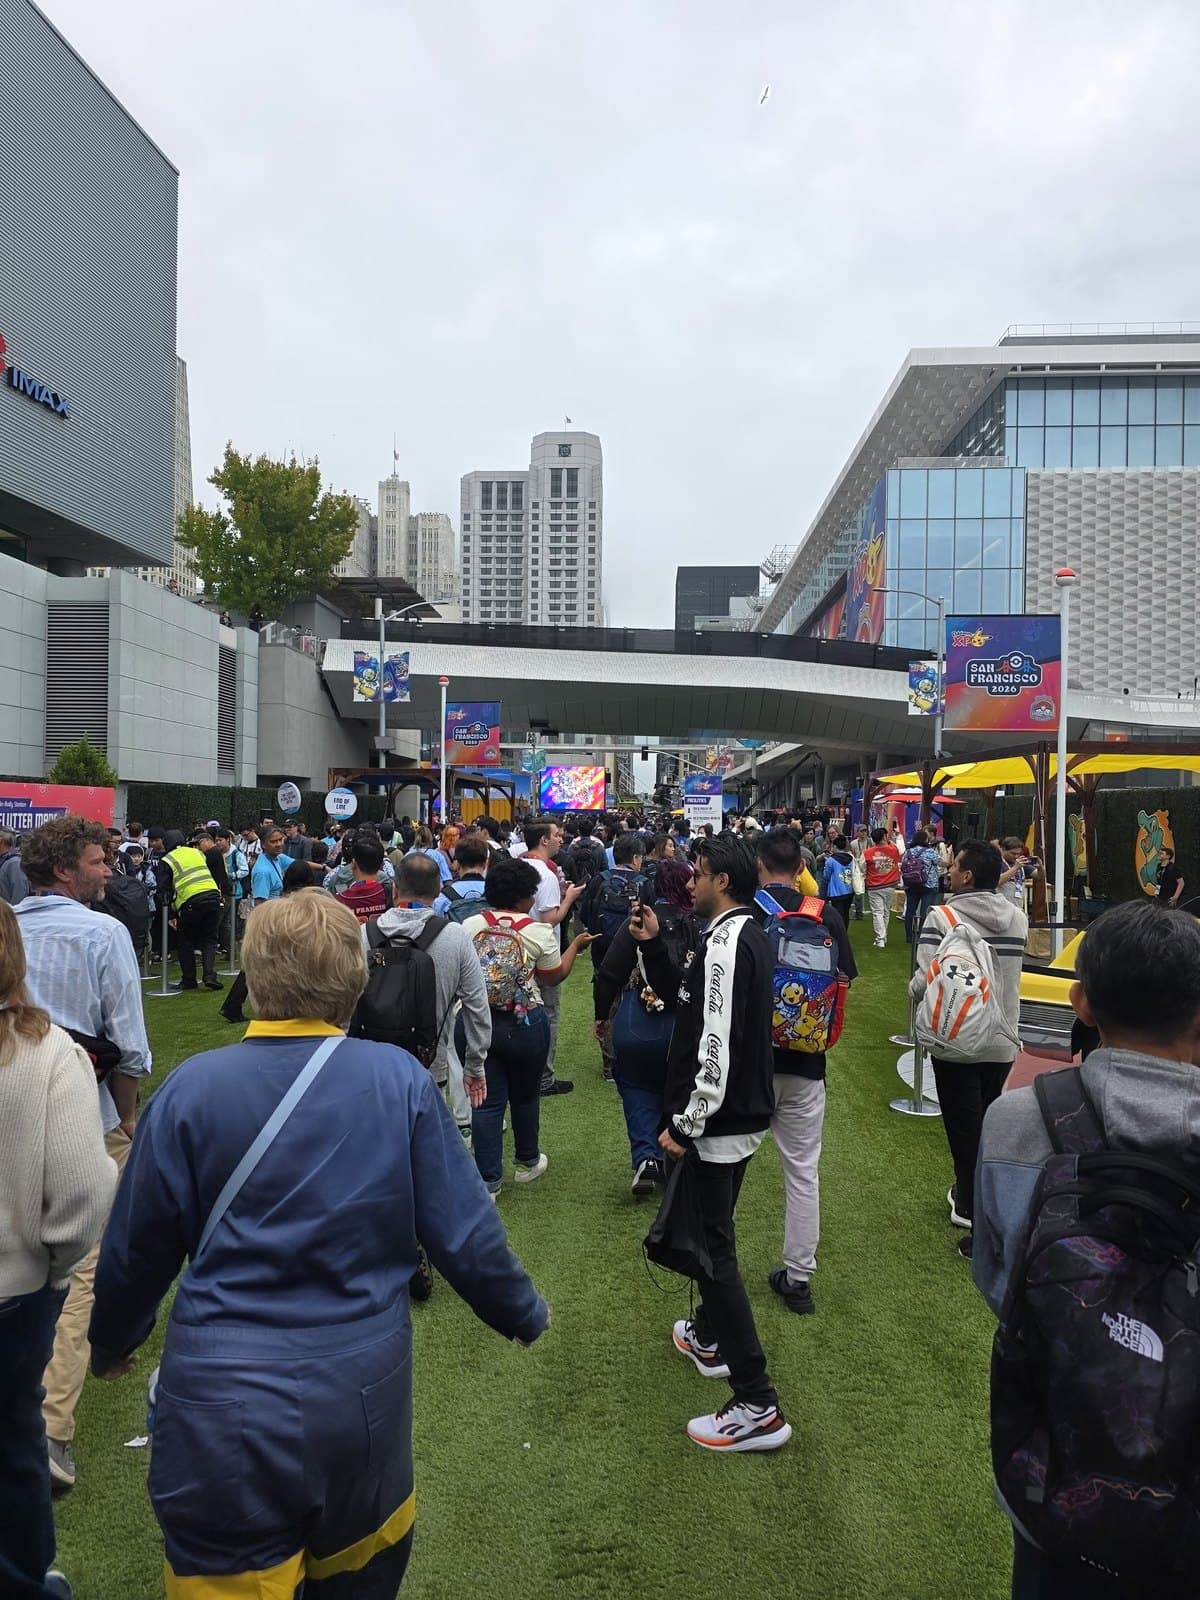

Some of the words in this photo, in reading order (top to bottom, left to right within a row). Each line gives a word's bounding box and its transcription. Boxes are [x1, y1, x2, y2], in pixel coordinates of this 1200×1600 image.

[11, 367, 70, 418] IMAX
[970, 663, 995, 673] SAN
[970, 673, 1038, 683] FRANCISCO
[948, 988, 959, 1010] UNDER
[941, 1009, 951, 1036] ARMOUR
[1101, 1312, 1139, 1343] NORTH
[1117, 1312, 1142, 1332] THE
[1109, 1328, 1139, 1352] FACE
